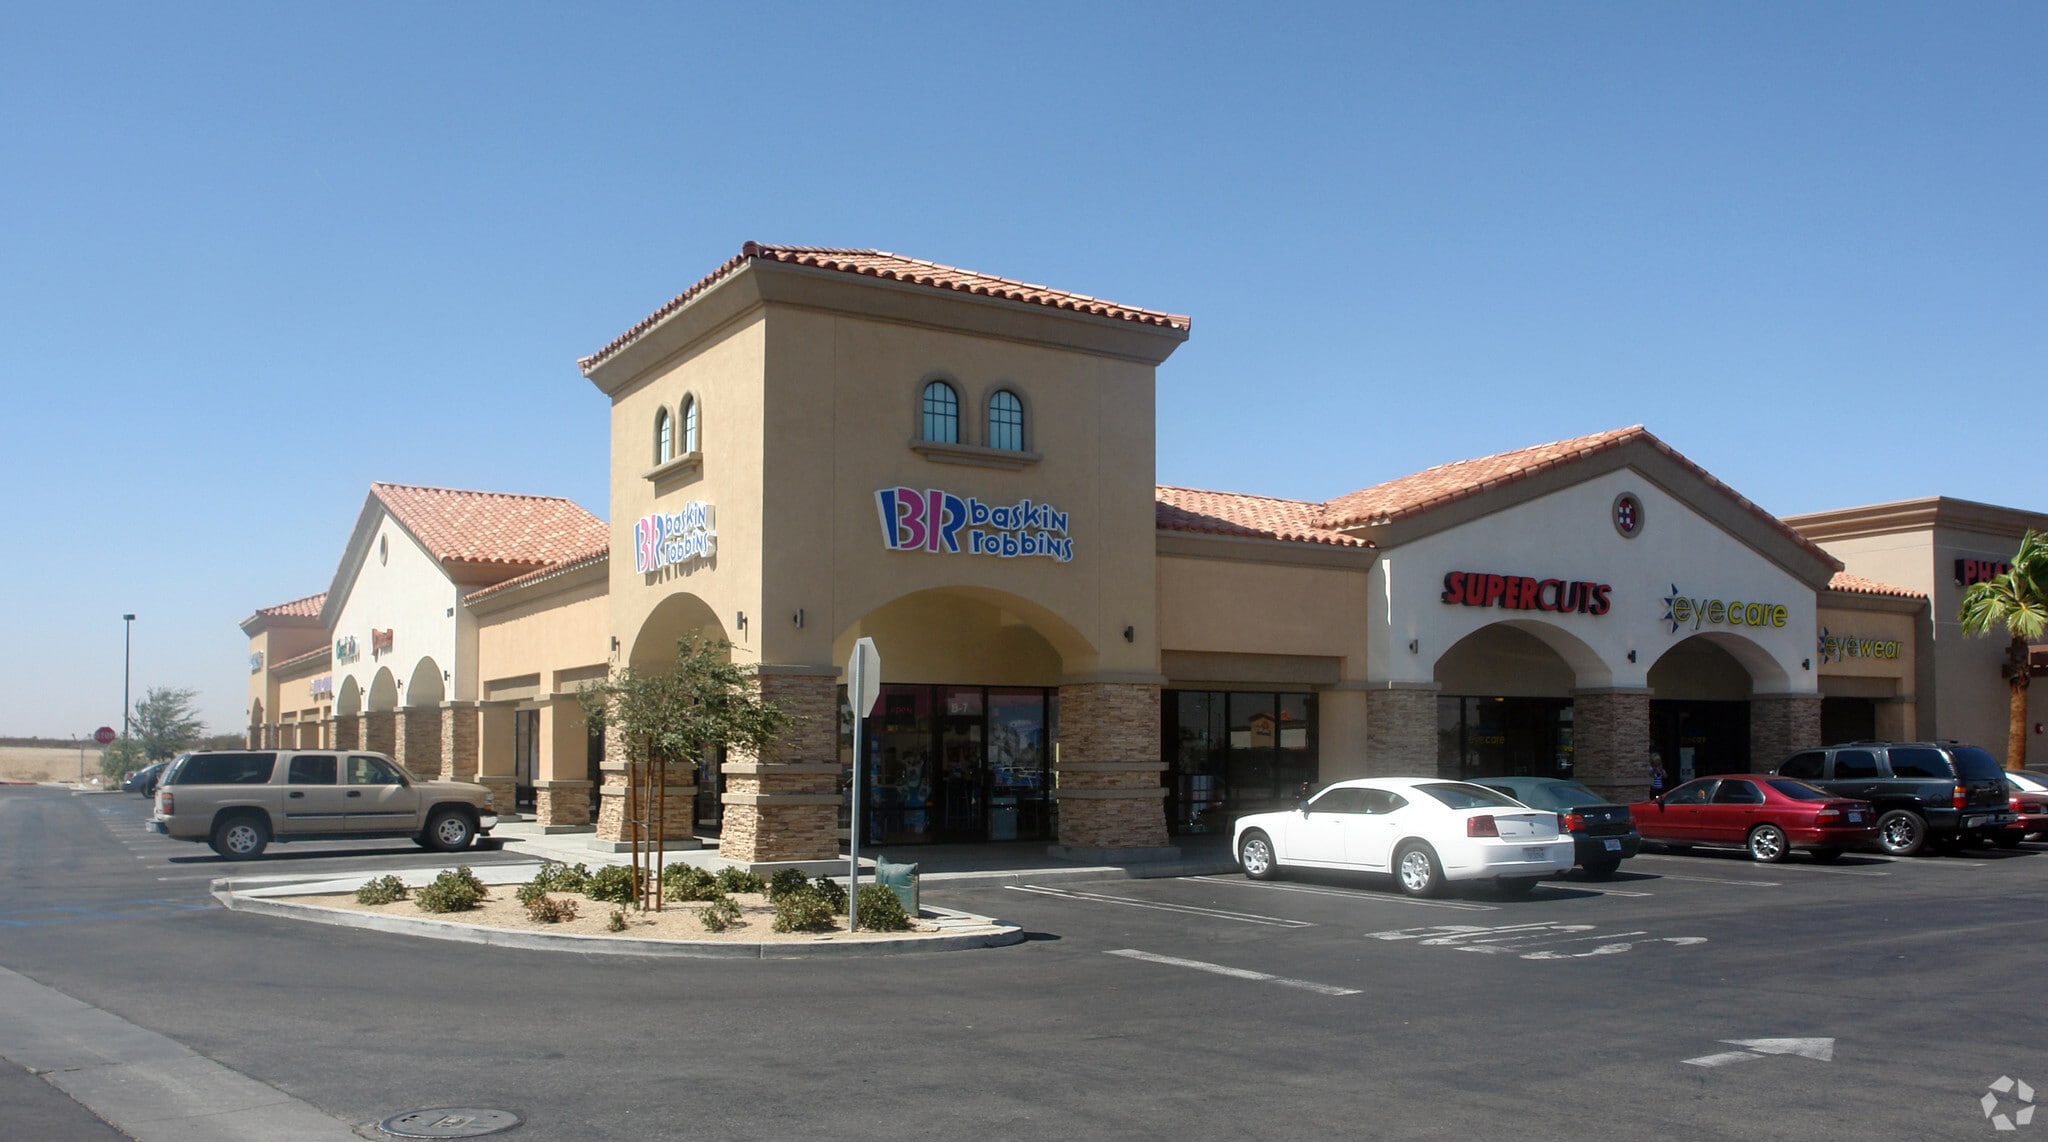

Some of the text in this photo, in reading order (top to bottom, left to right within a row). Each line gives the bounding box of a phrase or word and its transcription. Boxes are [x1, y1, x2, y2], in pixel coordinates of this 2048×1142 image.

[876, 487, 966, 553] BR
[634, 514, 664, 574] BR
[1956, 559, 2013, 586] PHA
[1442, 571, 1612, 615] SUPERCUTS
[1672, 596, 1788, 630] eyecare
[1824, 635, 1903, 661] eyewear
[951, 702, 969, 714] B-7
[95, 730, 115, 740] STOP
